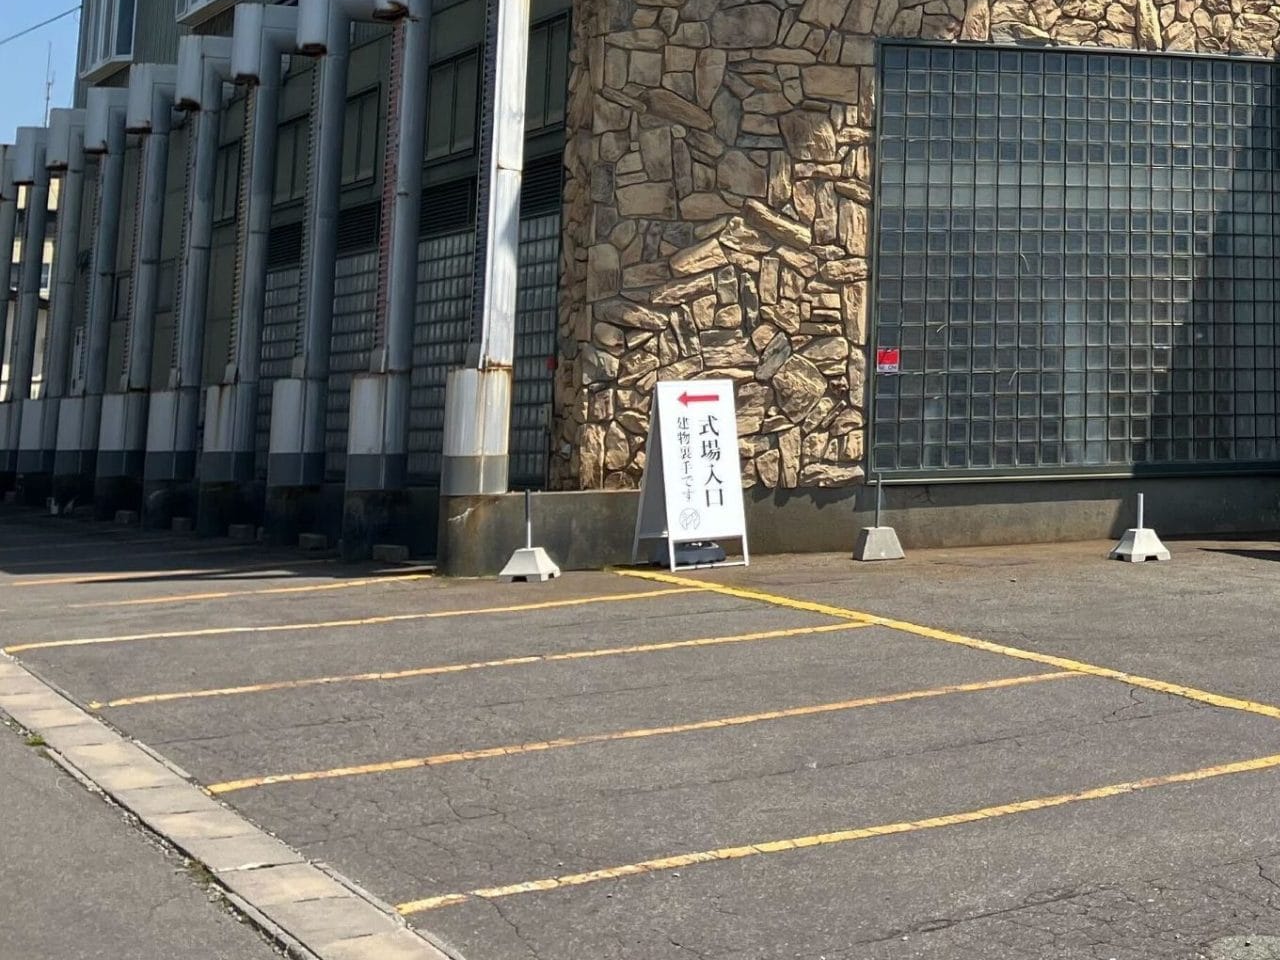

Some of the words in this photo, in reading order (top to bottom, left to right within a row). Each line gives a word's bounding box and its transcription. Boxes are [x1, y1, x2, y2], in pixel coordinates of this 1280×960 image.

[677, 417, 695, 503] 建物裏手です
[699, 415, 724, 508] 式場入口
